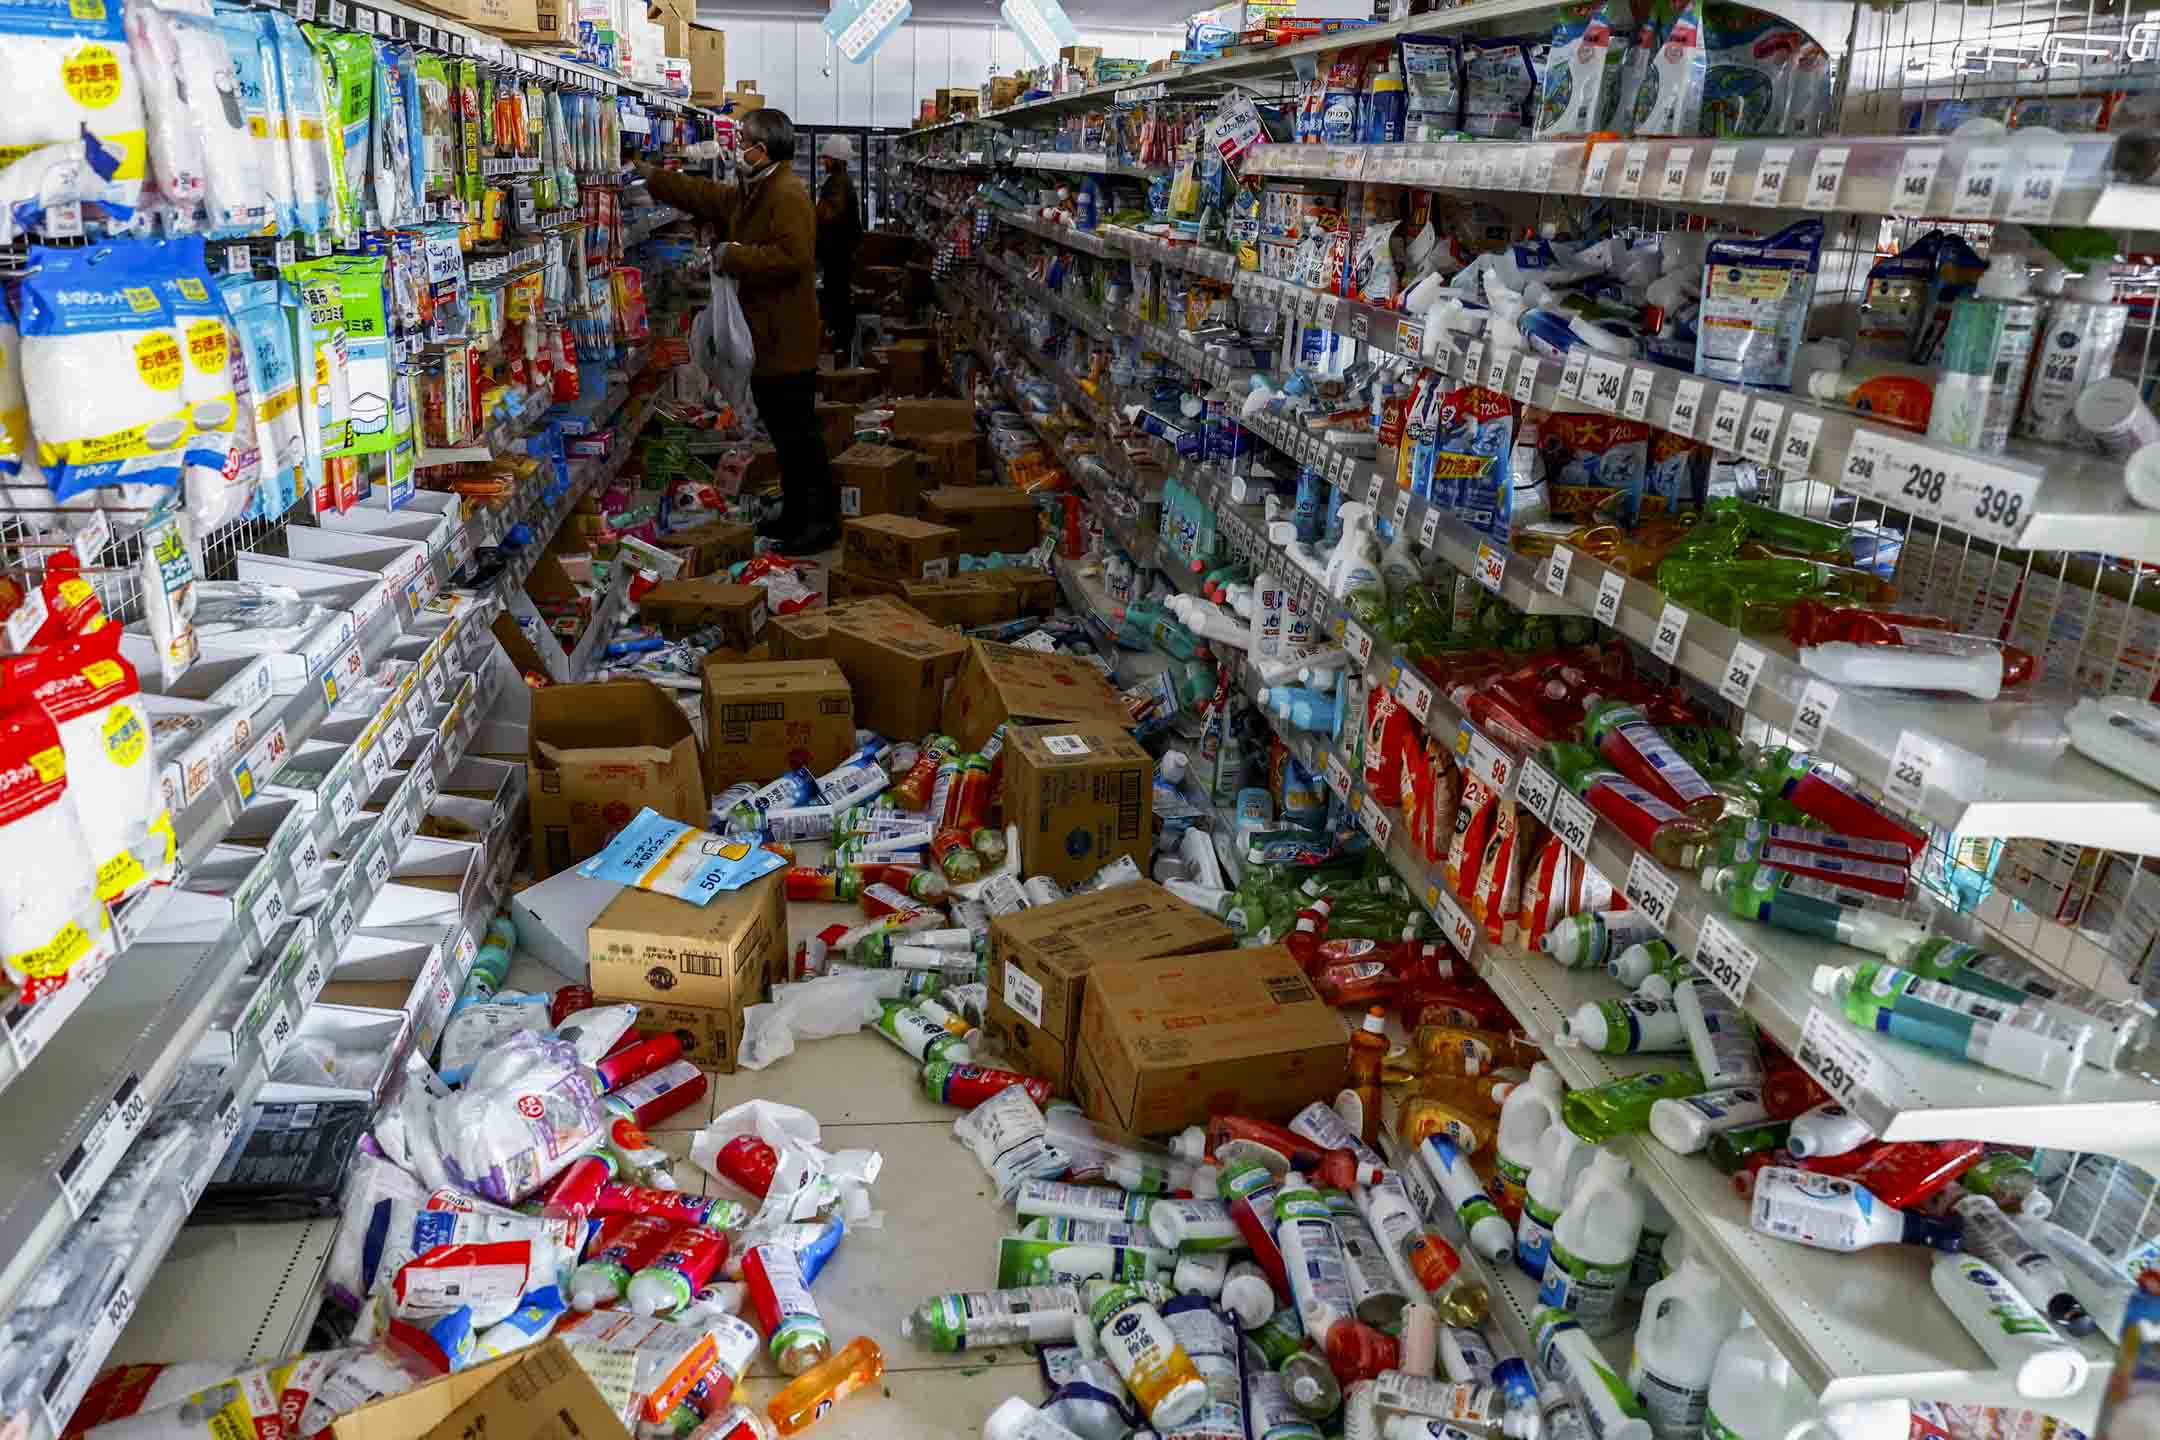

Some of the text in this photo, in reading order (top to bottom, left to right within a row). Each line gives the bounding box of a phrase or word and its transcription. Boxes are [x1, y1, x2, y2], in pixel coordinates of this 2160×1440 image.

[67, 64, 119, 85] お徳用
[1668, 169, 1682, 185] 148
[1711, 170, 1726, 186] 148
[1761, 172, 1780, 190] 148
[1815, 174, 1835, 192] 148
[1903, 176, 1926, 195] 148
[1967, 178, 1991, 198] 148
[2023, 179, 2051, 200] 148
[1596, 373, 1620, 401] 348
[1715, 416, 1735, 433] 448
[1750, 423, 1770, 443] 448
[1786, 437, 1810, 458] 298
[1848, 455, 1876, 479] 298
[1902, 463, 1946, 504] 298
[1974, 485, 2024, 529] 398
[1287, 623, 1311, 634] JOY
[1359, 639, 1370, 658] 98
[1416, 690, 1429, 712] 98
[1491, 758, 1506, 785] 98
[1895, 762, 1923, 789] 228
[1528, 790, 1547, 813] 297
[1375, 815, 1388, 842] 148
[1564, 821, 1586, 849] 297
[302, 843, 318, 870] 198
[266, 894, 283, 921] 128
[1641, 891, 1666, 921] 297
[1455, 917, 1472, 945] 148
[1713, 957, 1742, 993] 297
[272, 1015, 291, 1045] 198
[1819, 1057, 1855, 1098] 297
[121, 1094, 144, 1132] 300
[108, 1289, 130, 1328] 100
